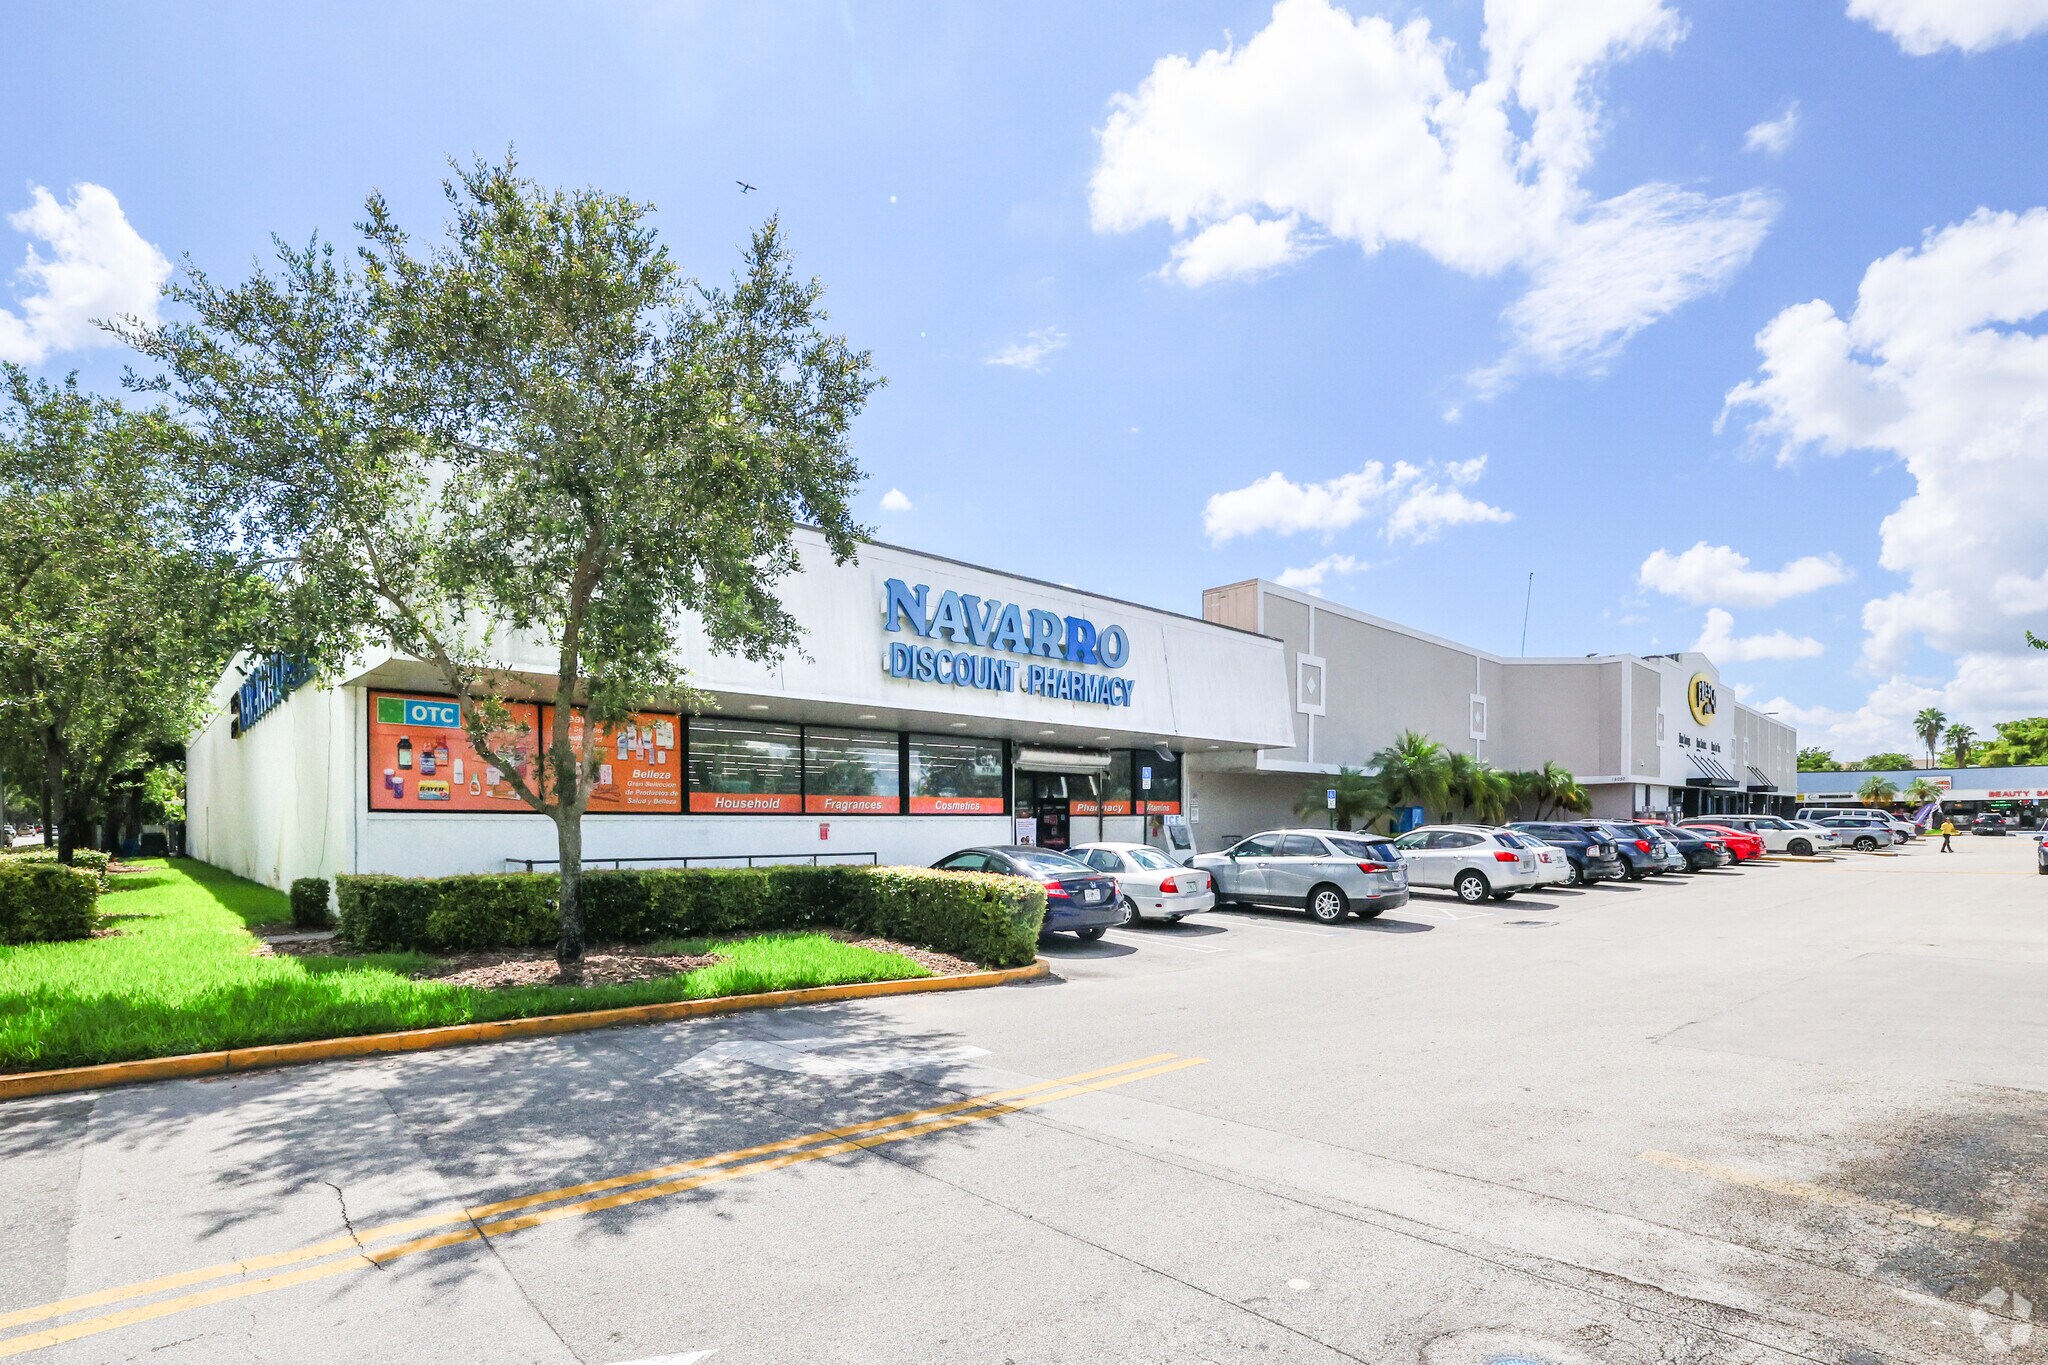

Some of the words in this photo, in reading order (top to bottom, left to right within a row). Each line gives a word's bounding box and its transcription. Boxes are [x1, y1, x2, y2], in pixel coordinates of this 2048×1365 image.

[884, 578, 1129, 669] NAVARRO
[889, 642, 1020, 693] DISCOUNT
[1028, 664, 1135, 707] PHARMACY
[411, 705, 454, 723] OTC
[632, 769, 672, 779] Belleza
[635, 789, 669, 797] Productos
[1988, 790, 2030, 798] BEAUTY
[715, 796, 782, 809] Household
[824, 798, 882, 812] Fragrances
[935, 800, 981, 811] Cosmetics
[1077, 803, 1124, 814] Pharacy
[1165, 815, 1180, 824] ICE
